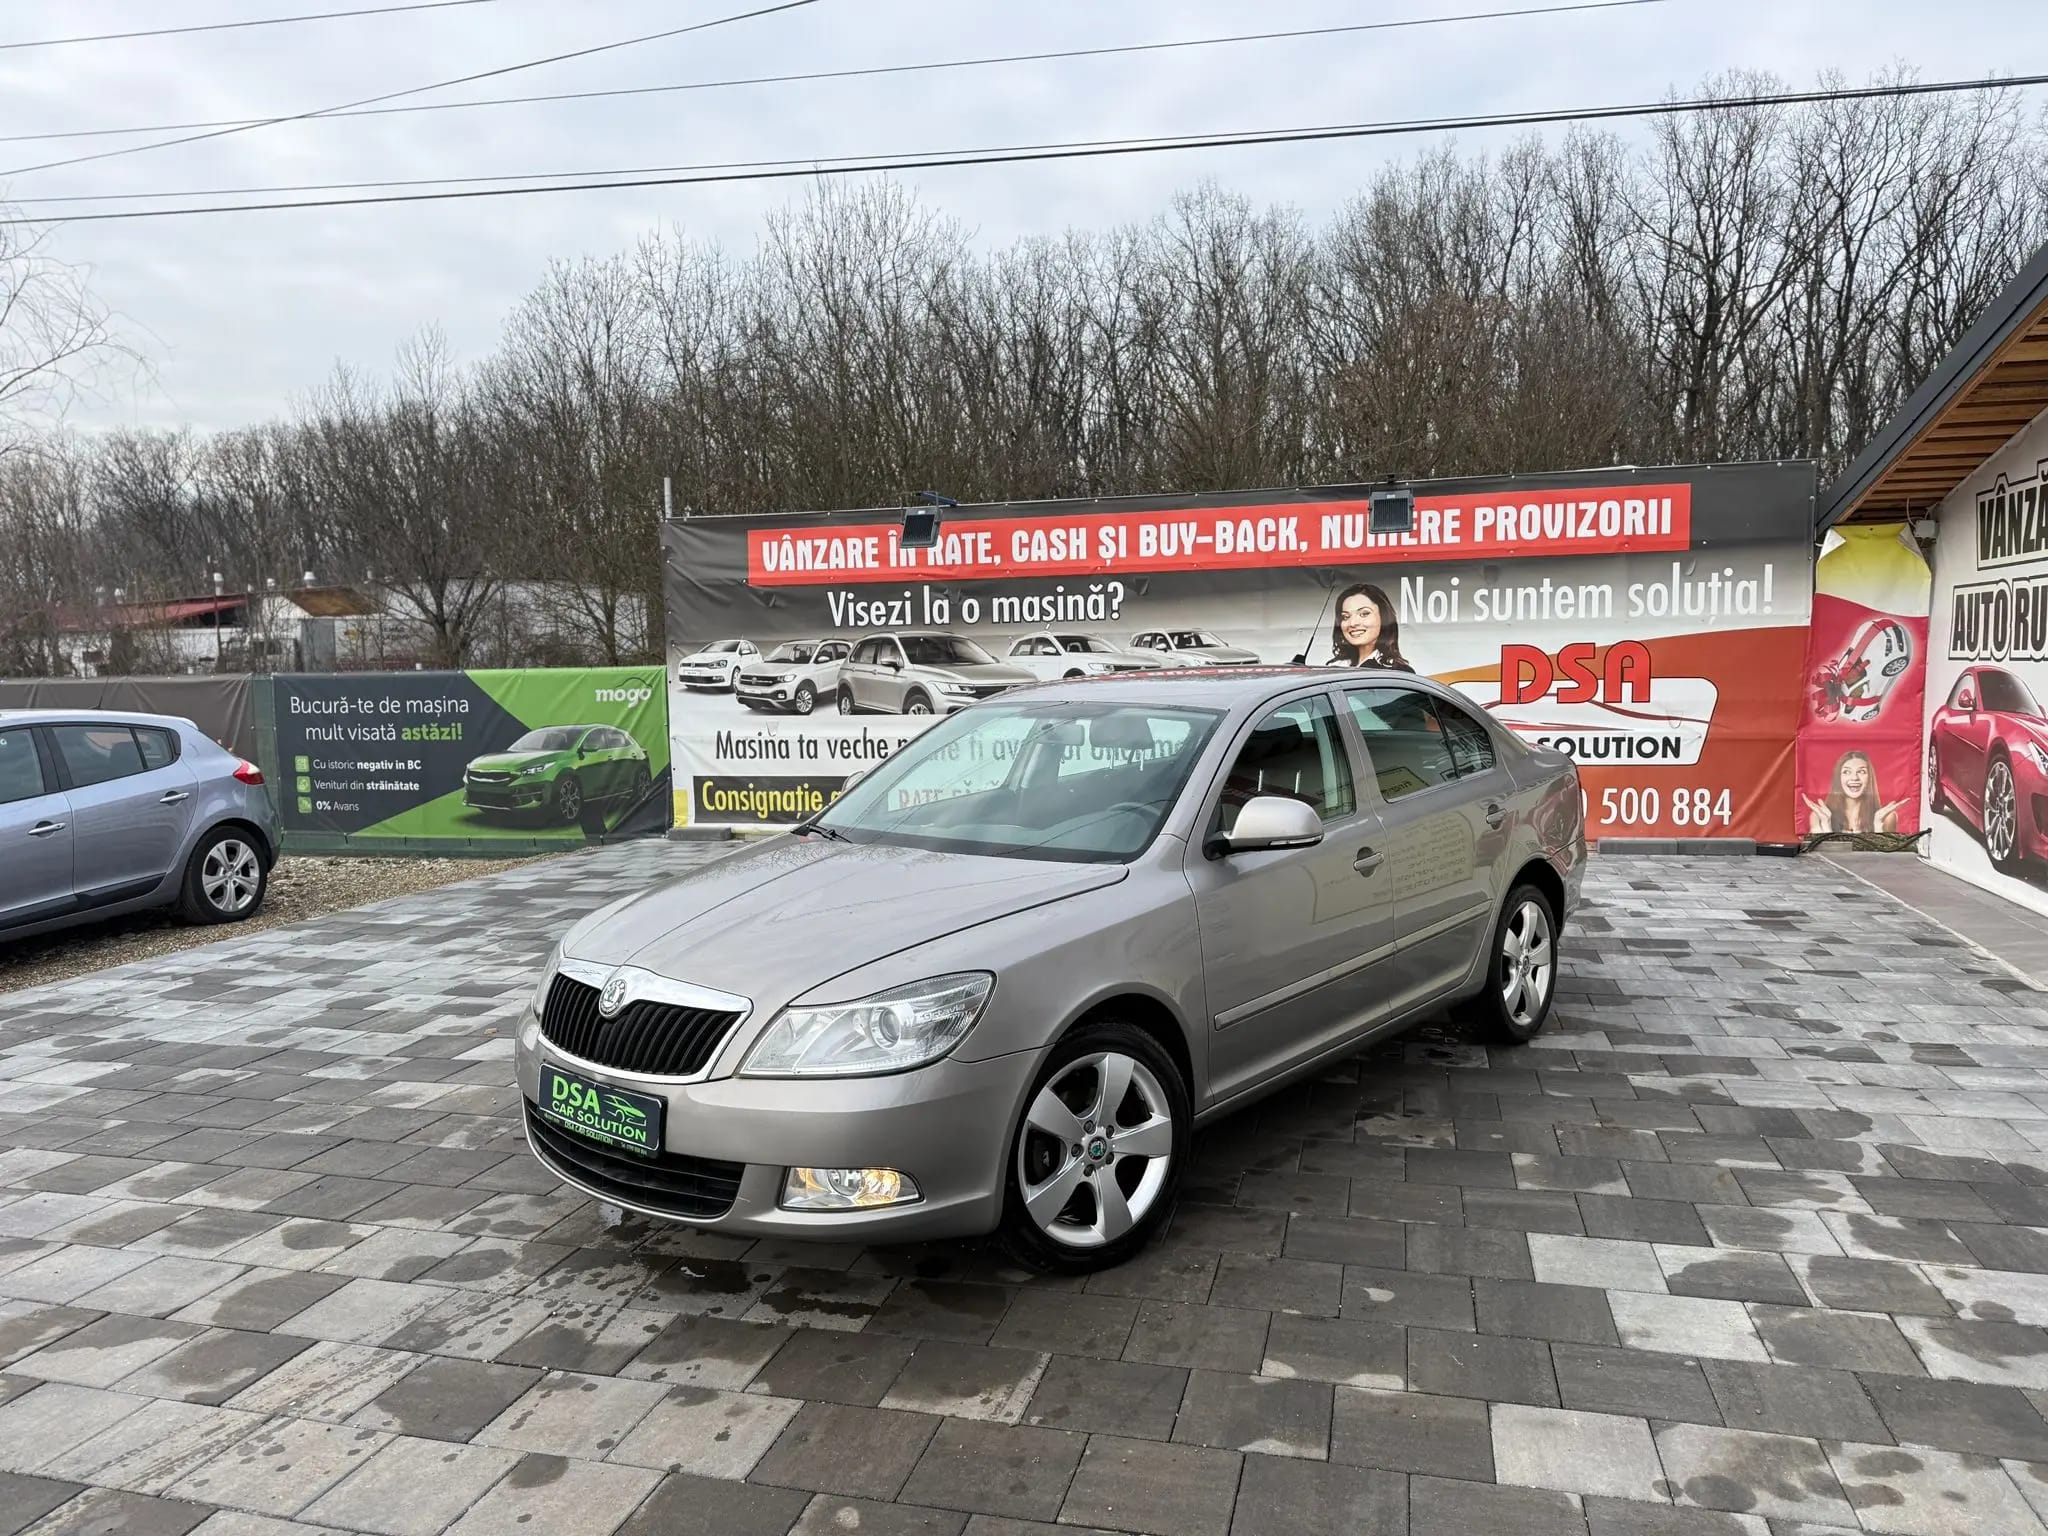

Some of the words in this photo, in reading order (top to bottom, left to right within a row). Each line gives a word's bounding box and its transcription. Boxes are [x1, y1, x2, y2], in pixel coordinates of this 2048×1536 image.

[762, 534, 880, 572] VÂNZARE
[927, 532, 1001, 567] RATE,
[1011, 527, 1087, 563] CASH
[1098, 526, 1127, 567] ȘI
[1139, 517, 1309, 558] BUY-BACK,
[1474, 498, 1672, 542] PROVIZORII
[827, 590, 912, 627] Visezi
[923, 585, 950, 625] la
[961, 597, 981, 624] o
[1400, 576, 1460, 624] Noi
[1473, 578, 1613, 622] suntem
[1628, 562, 1773, 625] soluția!
[1500, 640, 1652, 704] DSA
[290, 696, 374, 714] Bucură-te
[379, 696, 400, 714] de
[406, 695, 469, 717] mașina
[595, 688, 652, 708] mogo
[306, 723, 344, 741] mult
[348, 723, 396, 741] visată
[401, 722, 463, 741] astăzi!
[798, 734, 818, 759] ta
[827, 727, 889, 759] veche
[313, 759, 326, 769] Cu
[328, 759, 355, 769] istoric
[357, 760, 393, 772] negativ
[395, 760, 405, 770] in
[407, 760, 422, 770] BC
[314, 780, 348, 790] Venituri
[350, 780, 364, 790] din
[366, 780, 420, 791] străinătate
[702, 781, 823, 819] Consignație
[316, 801, 331, 811] 0%
[333, 801, 359, 811] Avans
[1600, 787, 1660, 825] 500
[1671, 787, 1732, 826] 884
[552, 1075, 600, 1115] DSA
[552, 1101, 575, 1118] CAR
[577, 1110, 647, 1143] SOLUTION
